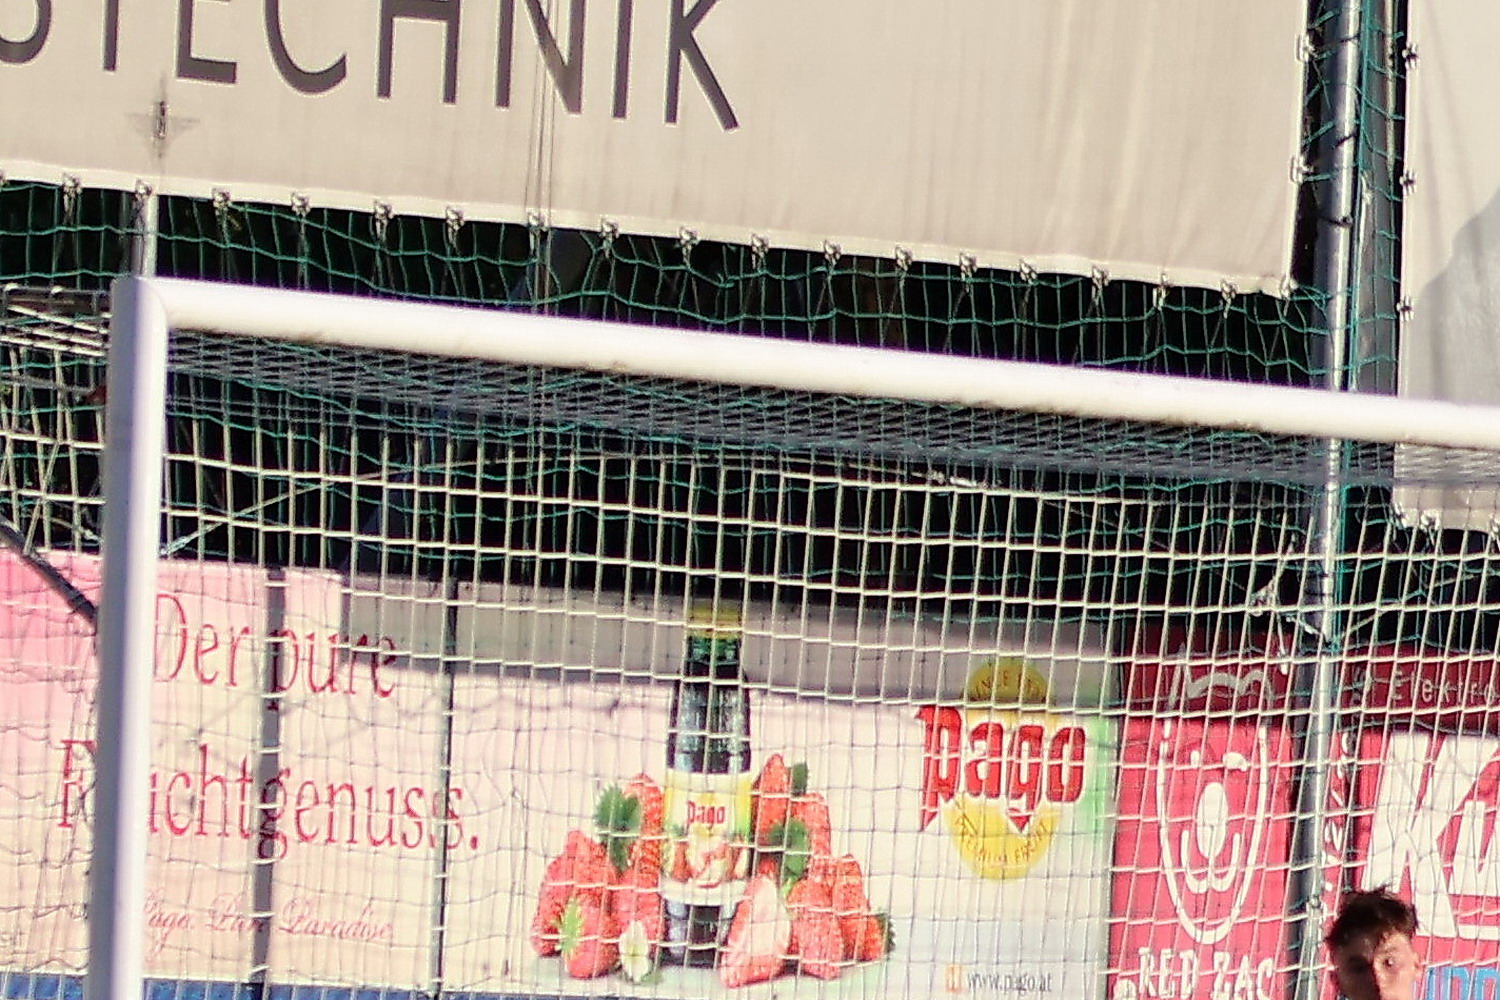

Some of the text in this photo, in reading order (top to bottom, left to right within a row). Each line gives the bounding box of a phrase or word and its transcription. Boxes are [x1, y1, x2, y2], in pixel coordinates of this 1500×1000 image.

[0, 0, 740, 132] ECHNIK
[152, 593, 400, 714] Der pure
[58, 740, 480, 860] Fchtgenuss.
[1139, 946, 1198, 1000] RED
